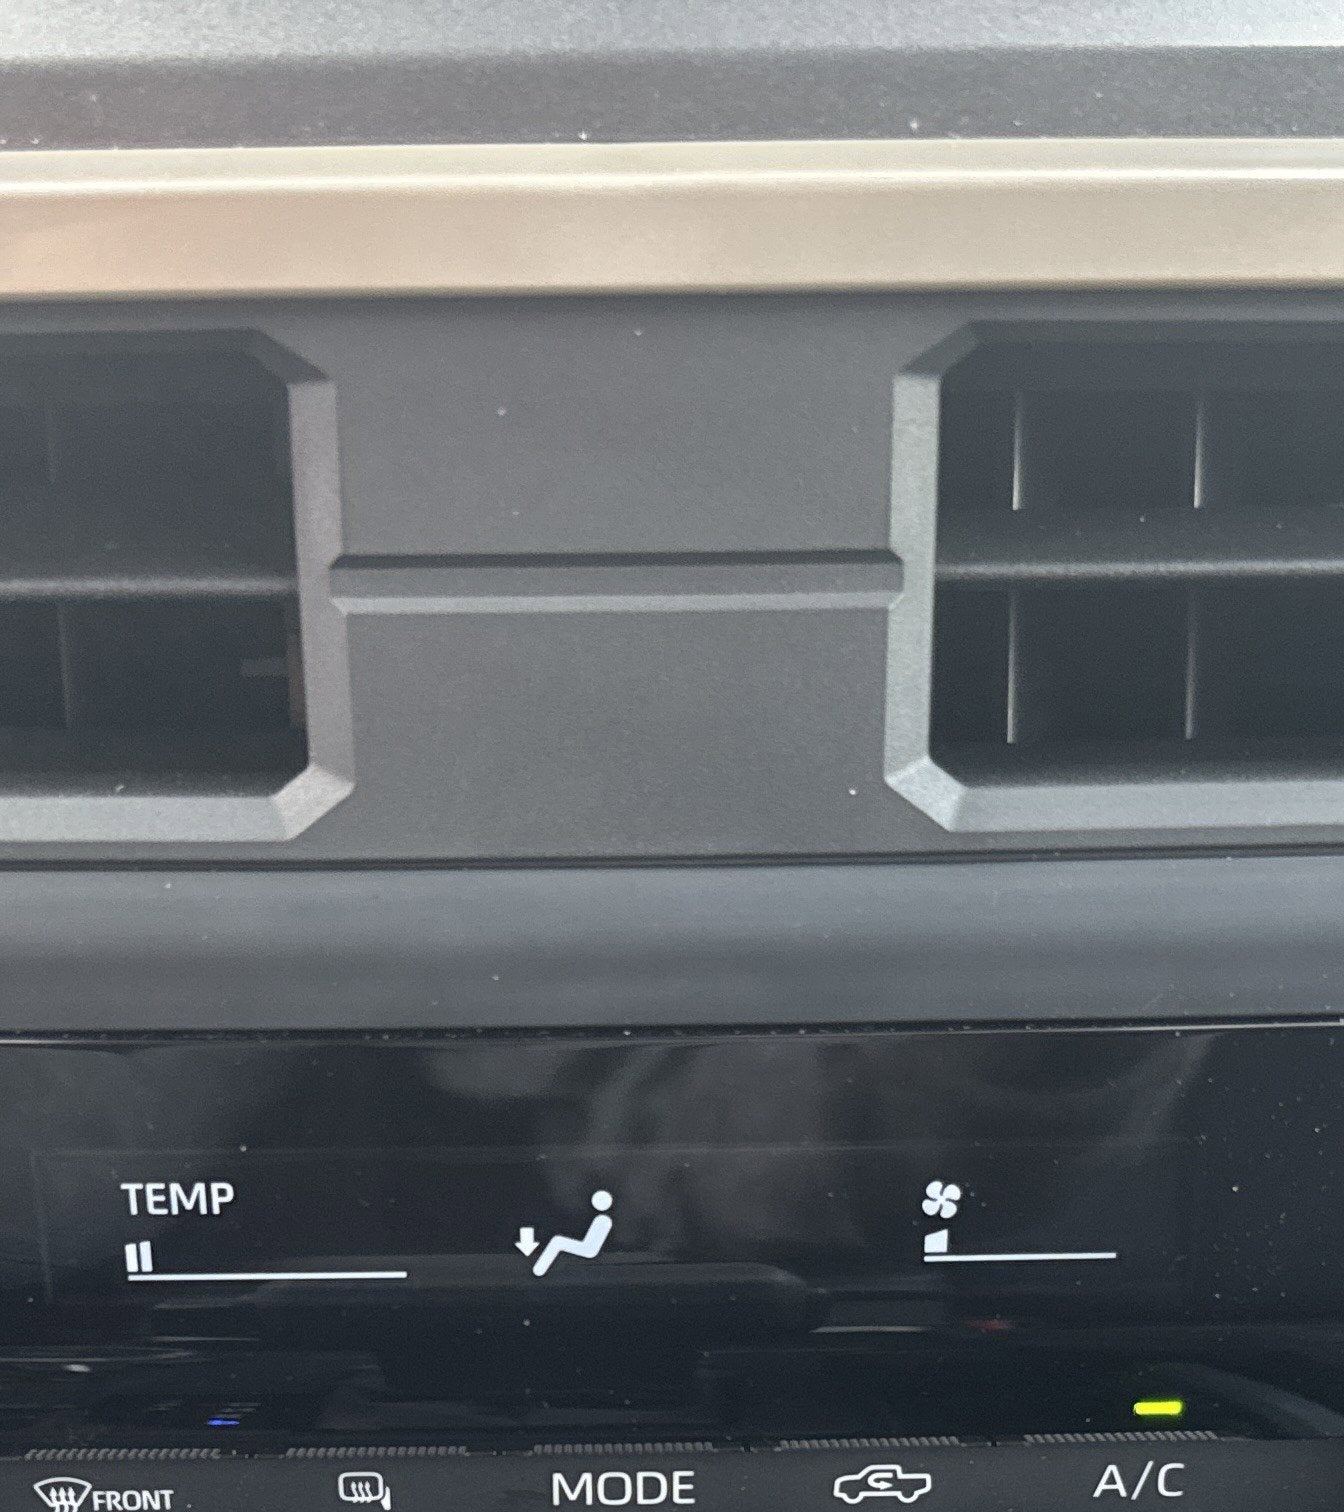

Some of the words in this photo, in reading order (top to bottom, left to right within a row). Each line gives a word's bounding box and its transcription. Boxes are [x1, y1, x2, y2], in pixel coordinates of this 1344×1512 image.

[120, 1183, 234, 1215] TEMP
[552, 1470, 696, 1506] MODE
[1092, 1461, 1185, 1500] A/C
[92, 1489, 174, 1512] FRONT
